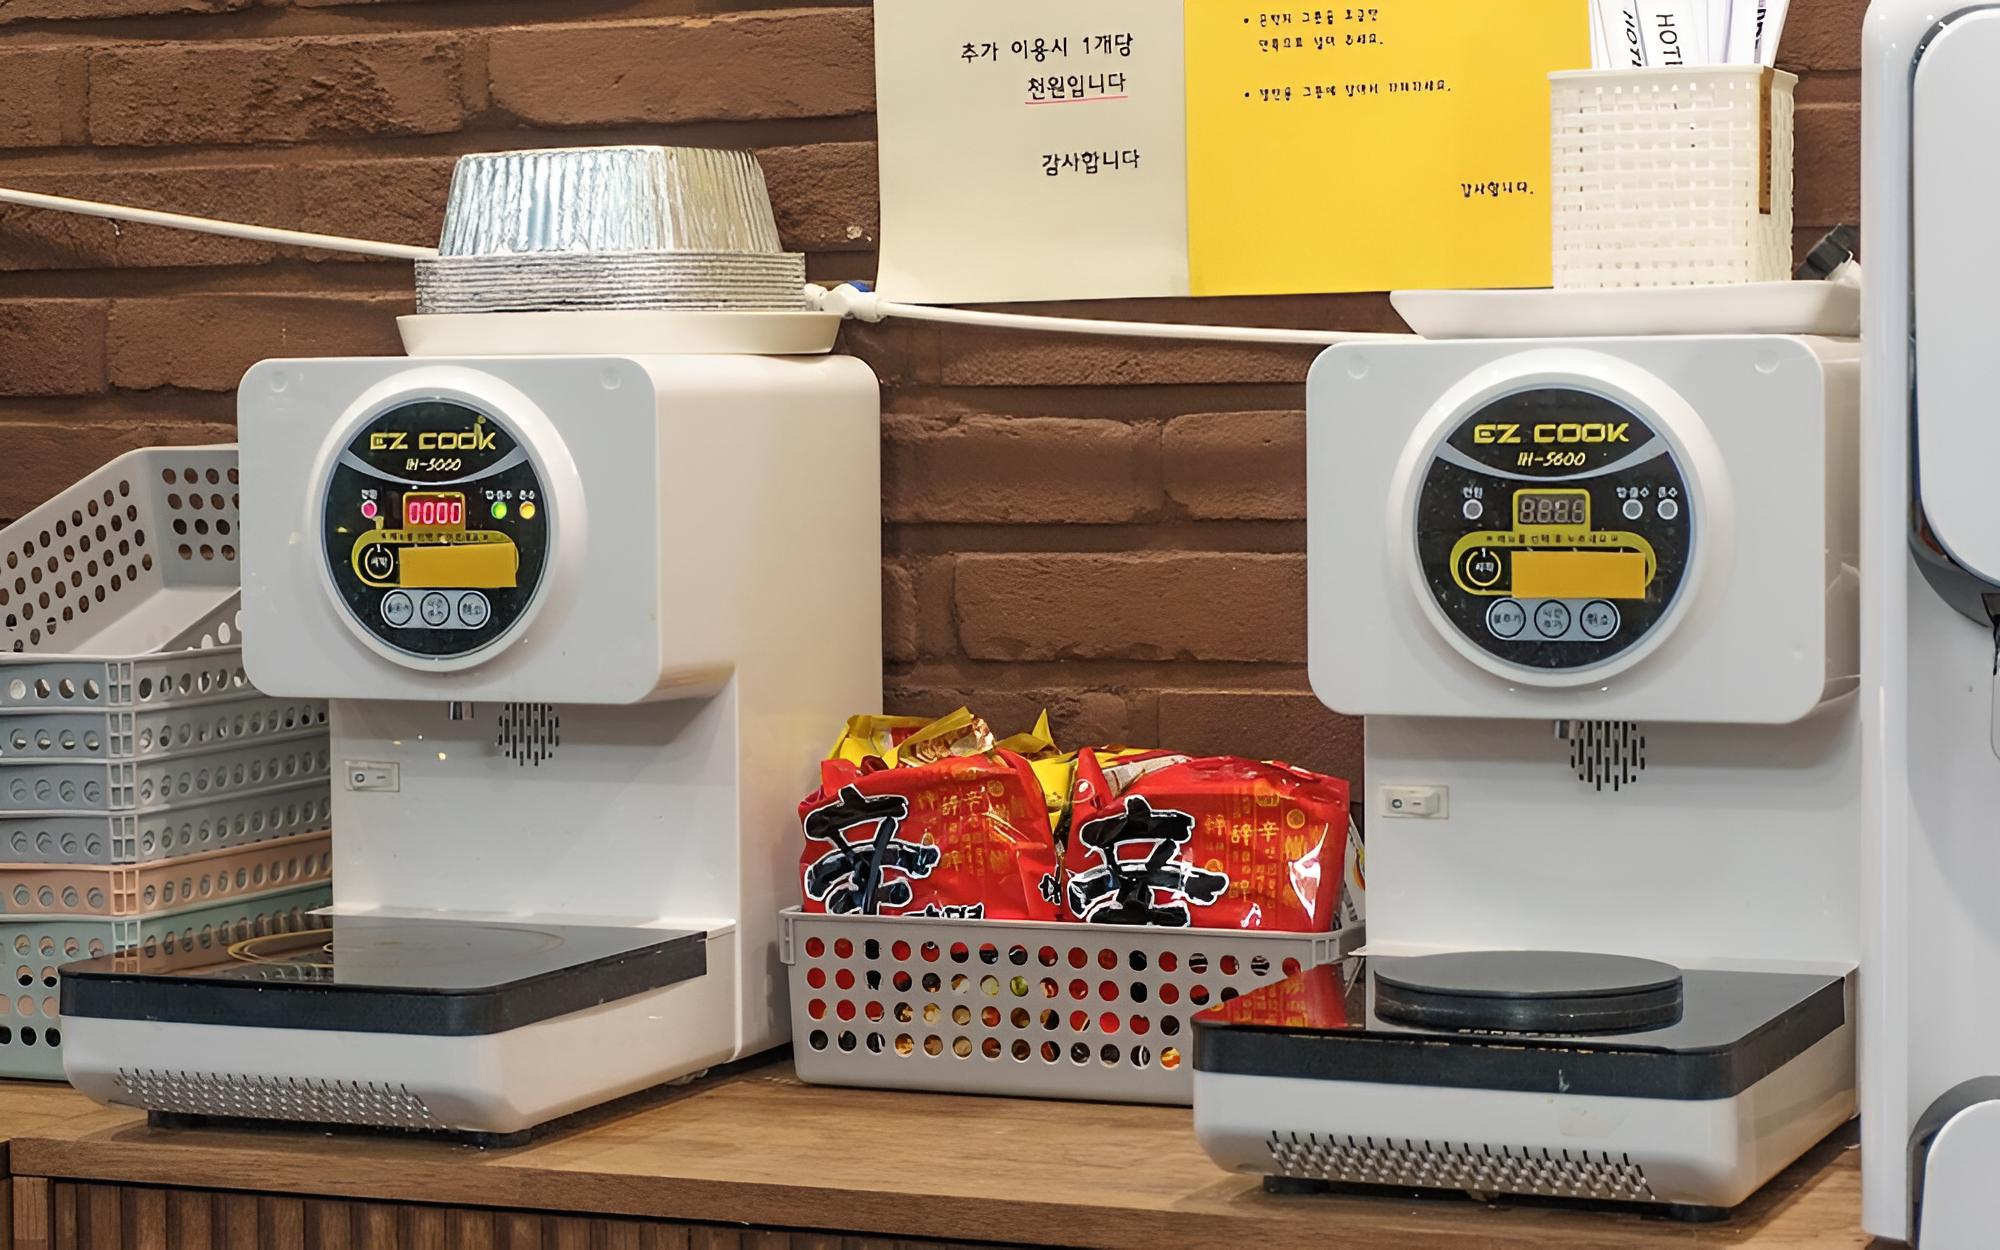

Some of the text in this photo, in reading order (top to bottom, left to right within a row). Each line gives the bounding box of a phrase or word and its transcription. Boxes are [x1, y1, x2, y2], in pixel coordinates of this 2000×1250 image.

[961, 32, 1134, 63] 추가 이용시 1개당
[1027, 72, 1126, 100] 천원입니다
[1041, 149, 1140, 176] 감사합니다
[369, 431, 409, 451] EZ
[1473, 422, 1631, 444] EZ COOK
